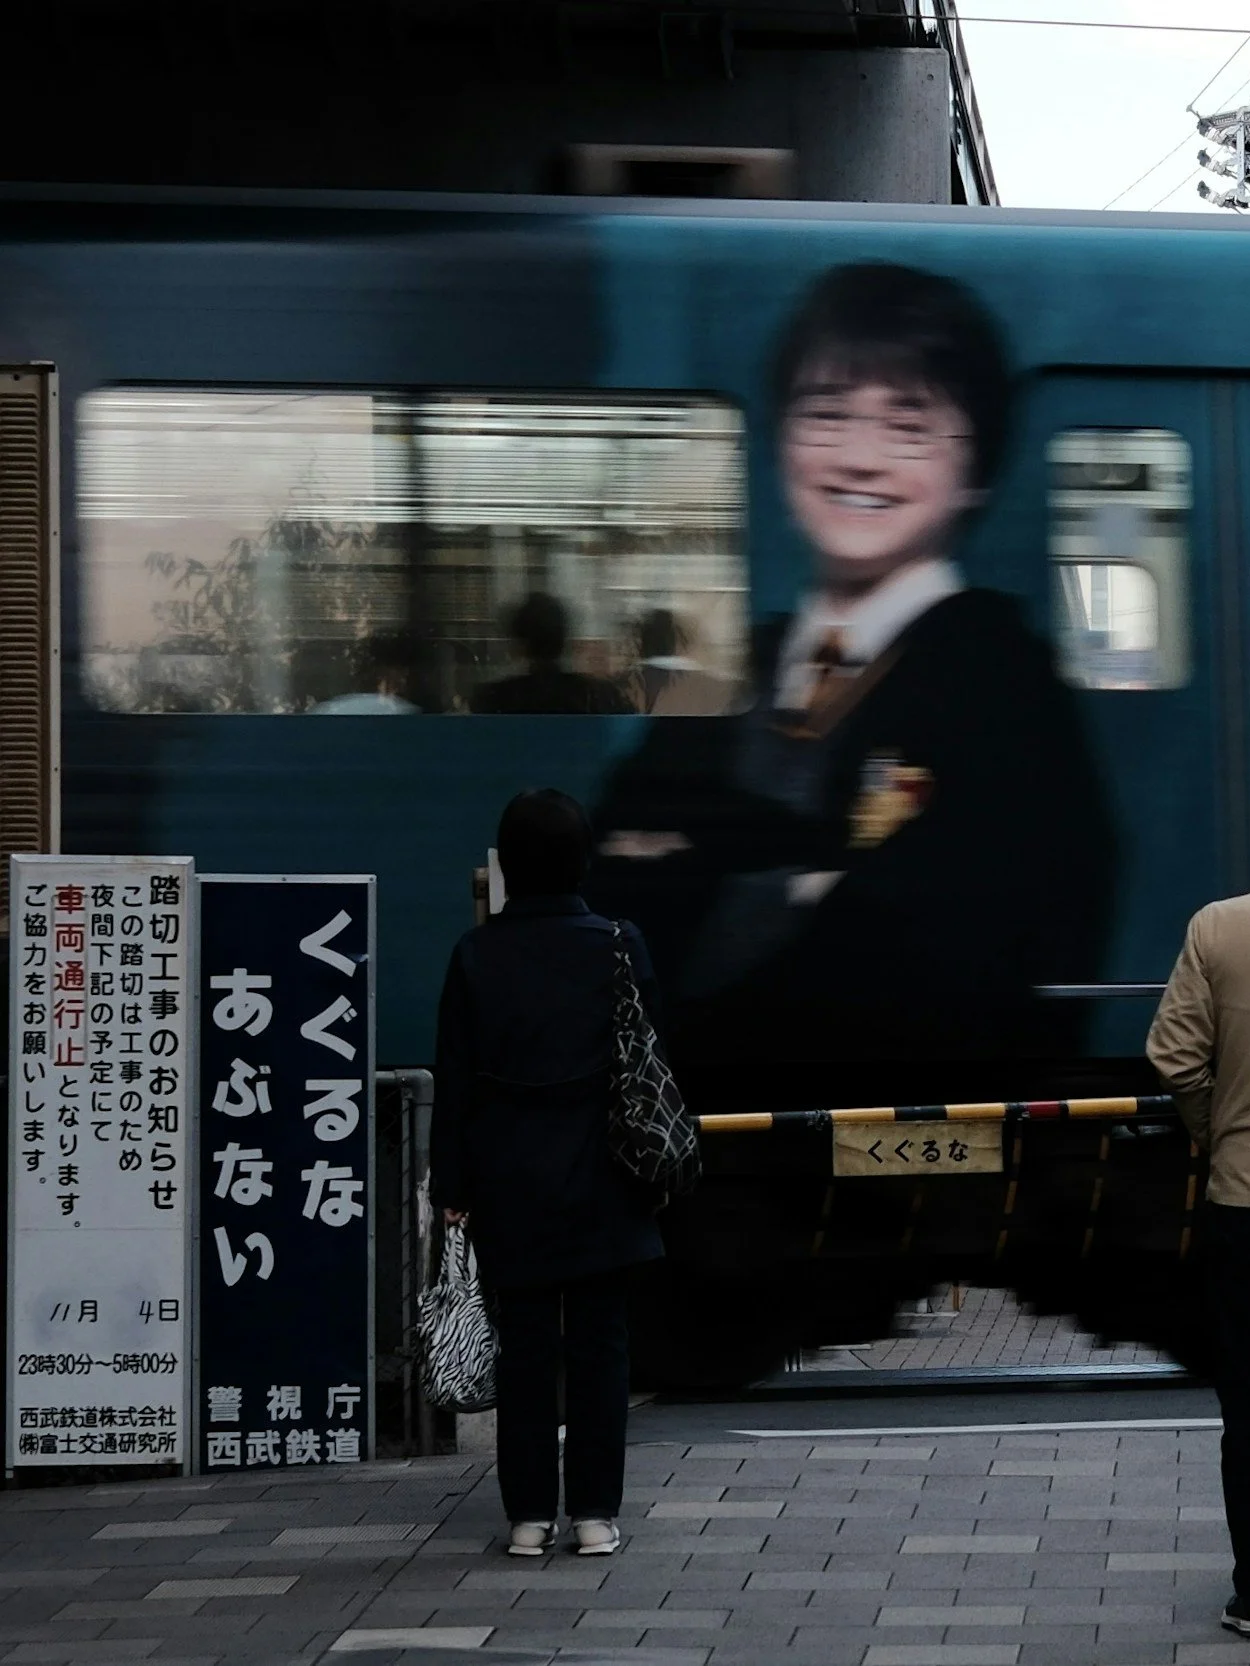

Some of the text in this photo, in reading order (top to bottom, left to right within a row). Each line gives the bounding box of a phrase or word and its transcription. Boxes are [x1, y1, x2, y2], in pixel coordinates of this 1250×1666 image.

[90, 884, 115, 1141] 夜間下記の予定にて
[119, 886, 144, 1171] この踏切は工事のため
[148, 875, 180, 1209] 踏切工事のお知らせ
[210, 968, 274, 1287] あぶない
[299, 909, 364, 1227] くぐるな
[867, 1139, 968, 1164] くぐるな
[19, 1405, 177, 1428] 西武鉄道株式会社
[206, 1427, 361, 1466] 西武鉄道
